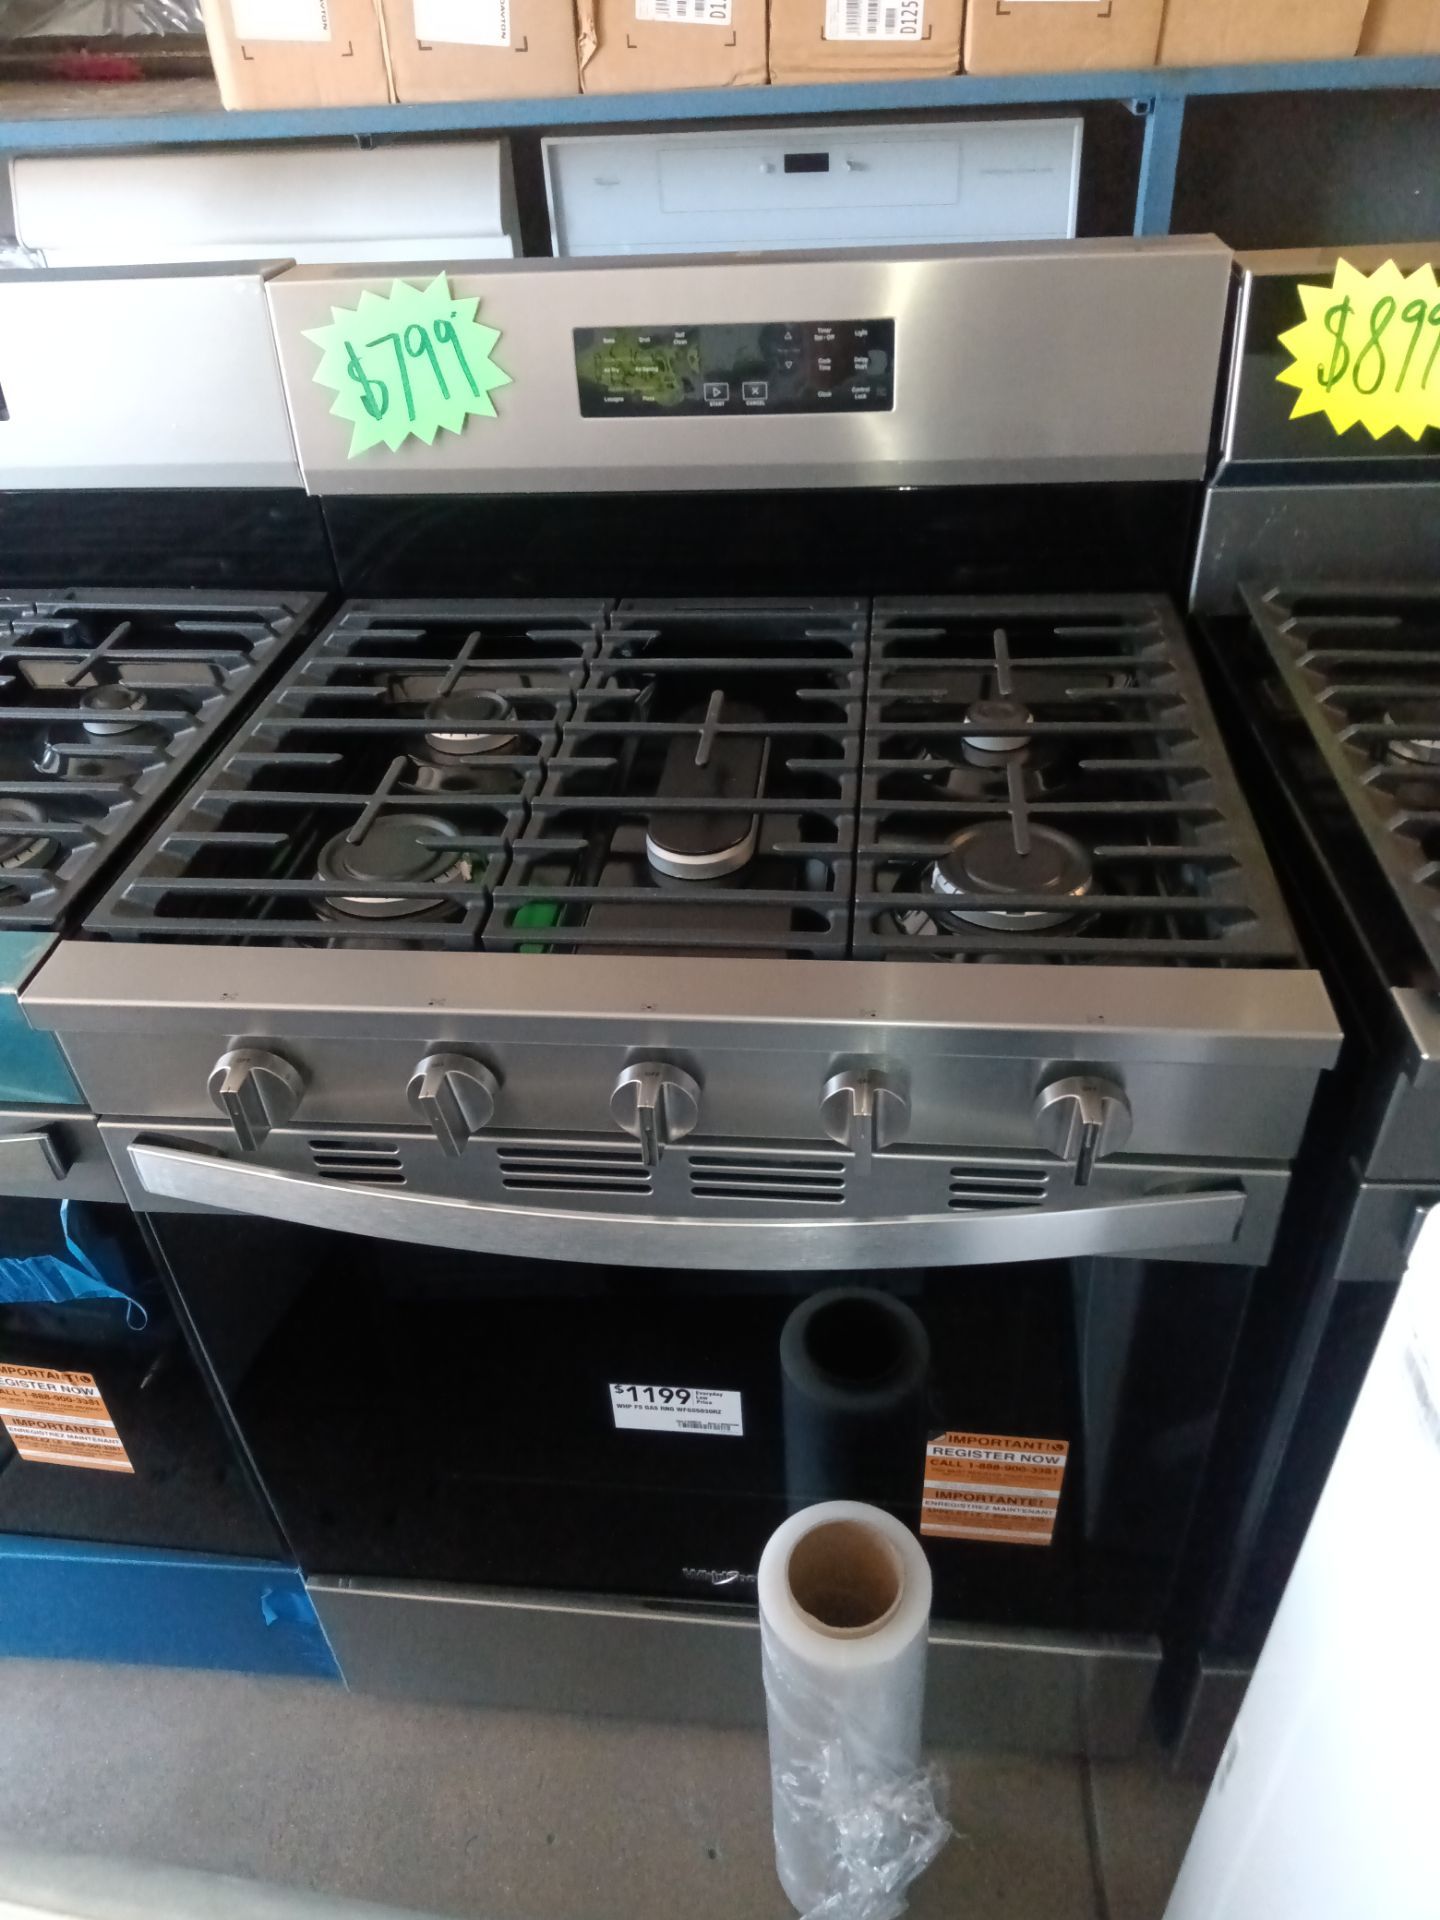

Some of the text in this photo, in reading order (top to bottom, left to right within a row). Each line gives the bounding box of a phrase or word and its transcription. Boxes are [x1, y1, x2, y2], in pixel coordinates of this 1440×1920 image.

[0, 1377, 94, 1396] EGISTER NOW
[0, 1388, 18, 1396] ALL
[614, 1384, 691, 1405] $1199
[930, 1459, 962, 1468] CALL
[932, 1447, 1061, 1465] REGISTER NOW
